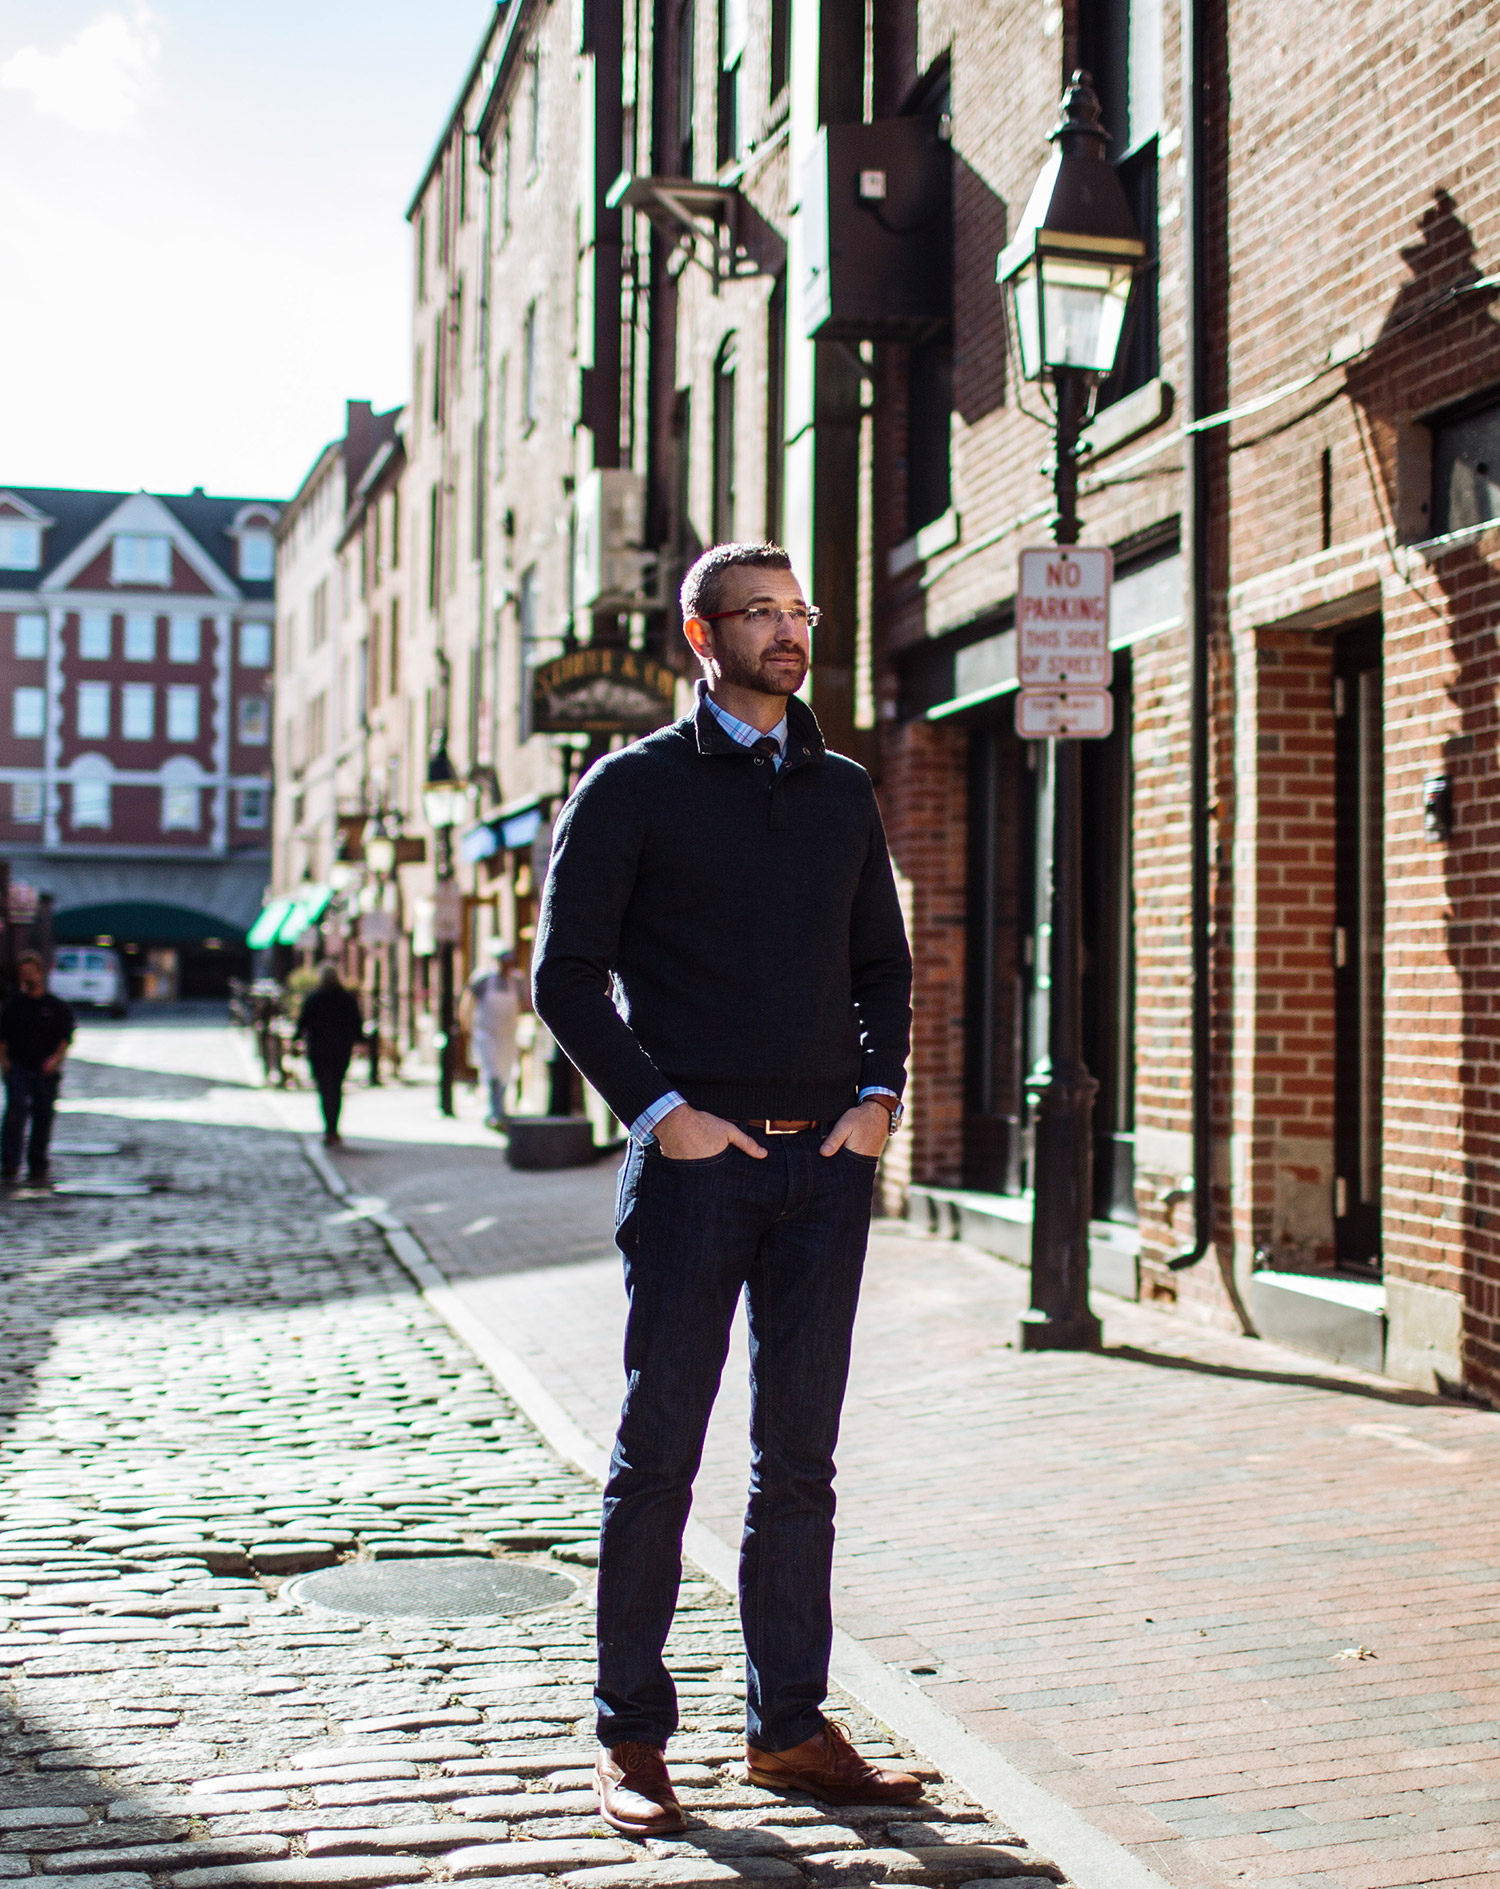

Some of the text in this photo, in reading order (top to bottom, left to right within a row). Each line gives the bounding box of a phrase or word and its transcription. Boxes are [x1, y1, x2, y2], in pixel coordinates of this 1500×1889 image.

[1046, 562, 1081, 588] NO
[1024, 596, 1105, 622] PARKING
[1027, 630, 1102, 649] THIS SIDE
[1023, 656, 1102, 674] OF STREET
